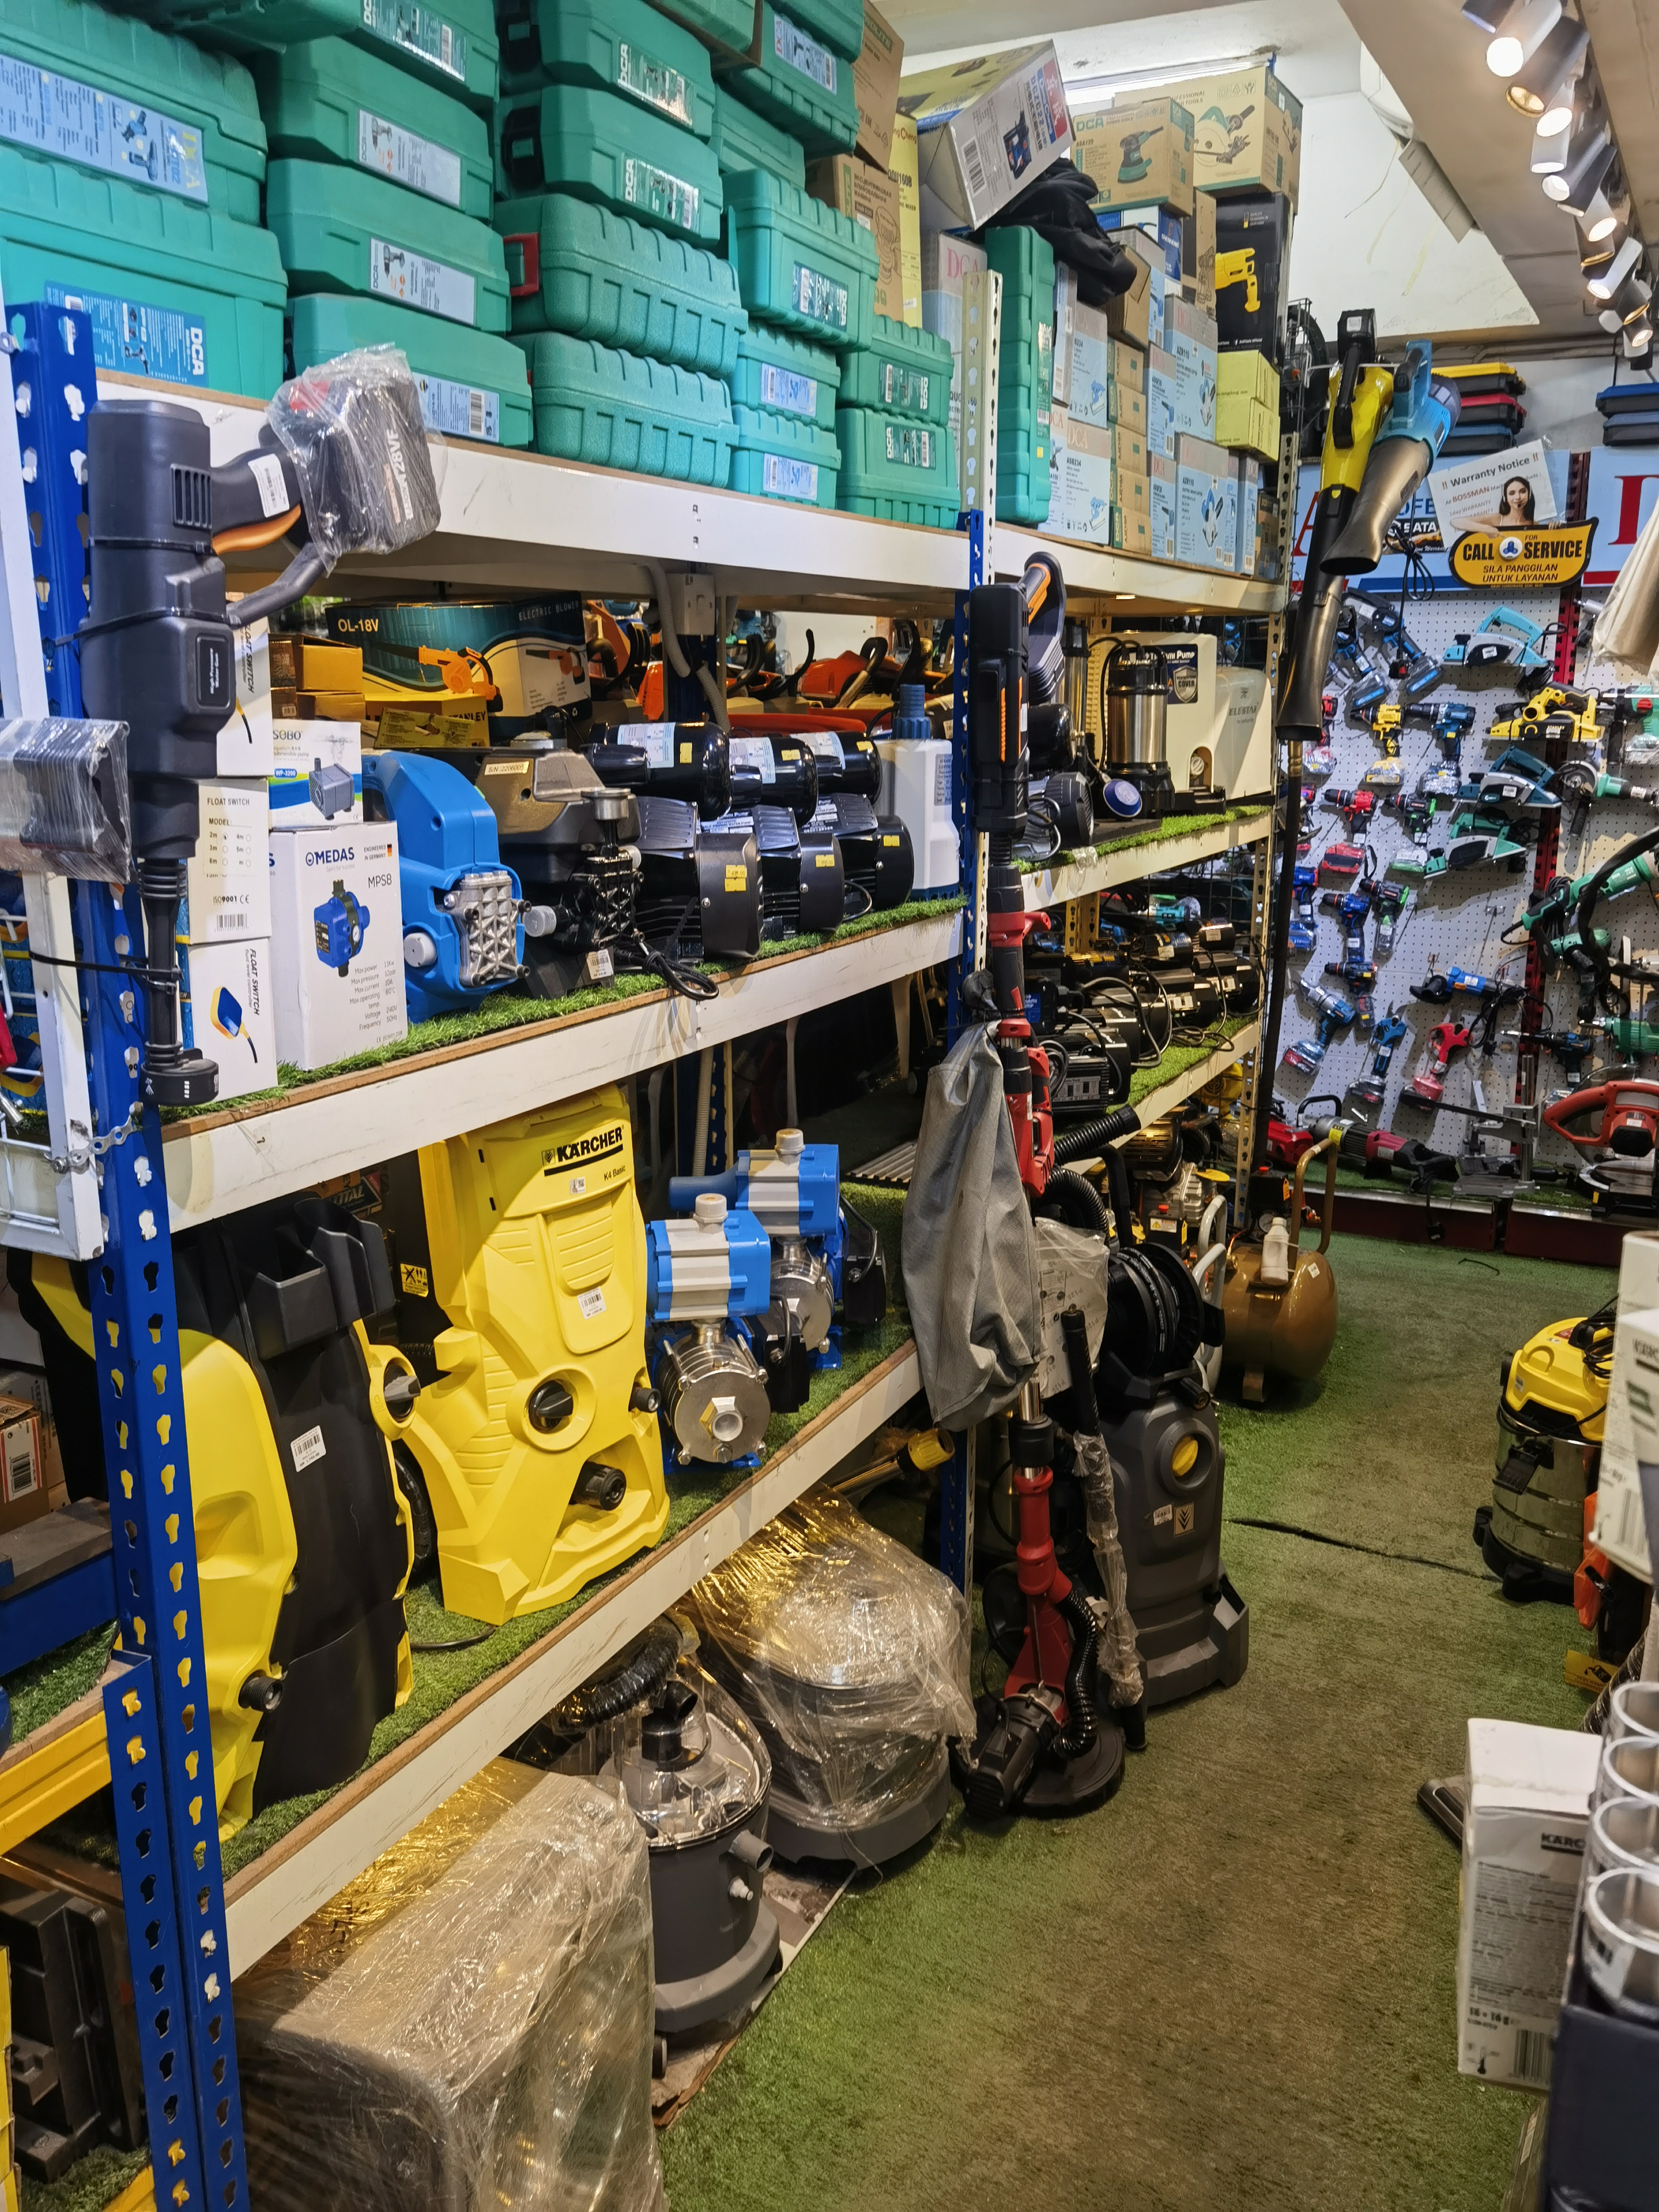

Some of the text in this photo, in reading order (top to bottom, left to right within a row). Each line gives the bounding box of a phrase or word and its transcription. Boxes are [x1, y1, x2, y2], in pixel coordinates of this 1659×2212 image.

[621, 43, 629, 84] DCA
[1076, 116, 1104, 133] DCA
[625, 158, 635, 203] DCA
[946, 247, 979, 279] DCA
[190, 327, 205, 376] DCA
[1067, 425, 1089, 449] DCA
[1450, 467, 1496, 487] Warranty
[1498, 457, 1530, 473] Notice
[1452, 487, 1490, 503] BOSSMAN
[1462, 500, 1492, 513] WARRANTY
[1462, 540, 1582, 561] CALL SERVICE
[1483, 564, 1558, 574] SILA PANGGILAN
[1482, 573, 1558, 583] UNTUK LAYANAN
[518, 599, 580, 622] ELECTRIC BLOWER
[338, 618, 379, 632] OL-18V
[246, 653, 255, 694] SWITCH
[1178, 680, 1195, 688] COVER
[272, 729, 301, 740] SOBO
[207, 798, 226, 806] FLOAT
[364, 844, 386, 853] ENGINEERED
[369, 853, 386, 861] GERMANY
[368, 873, 392, 889] MPS8
[364, 965, 377, 974] power
[249, 948, 260, 1015] FLOAT SWITCH
[361, 974, 379, 984] pressure
[364, 983, 380, 992] current
[360, 992, 380, 1003] operating
[365, 1010, 381, 1020] Voltage
[359, 1020, 381, 1031] Frequency
[557, 1126, 623, 1163] KÄRCHER
[604, 1164, 626, 1181] K4 Basic
